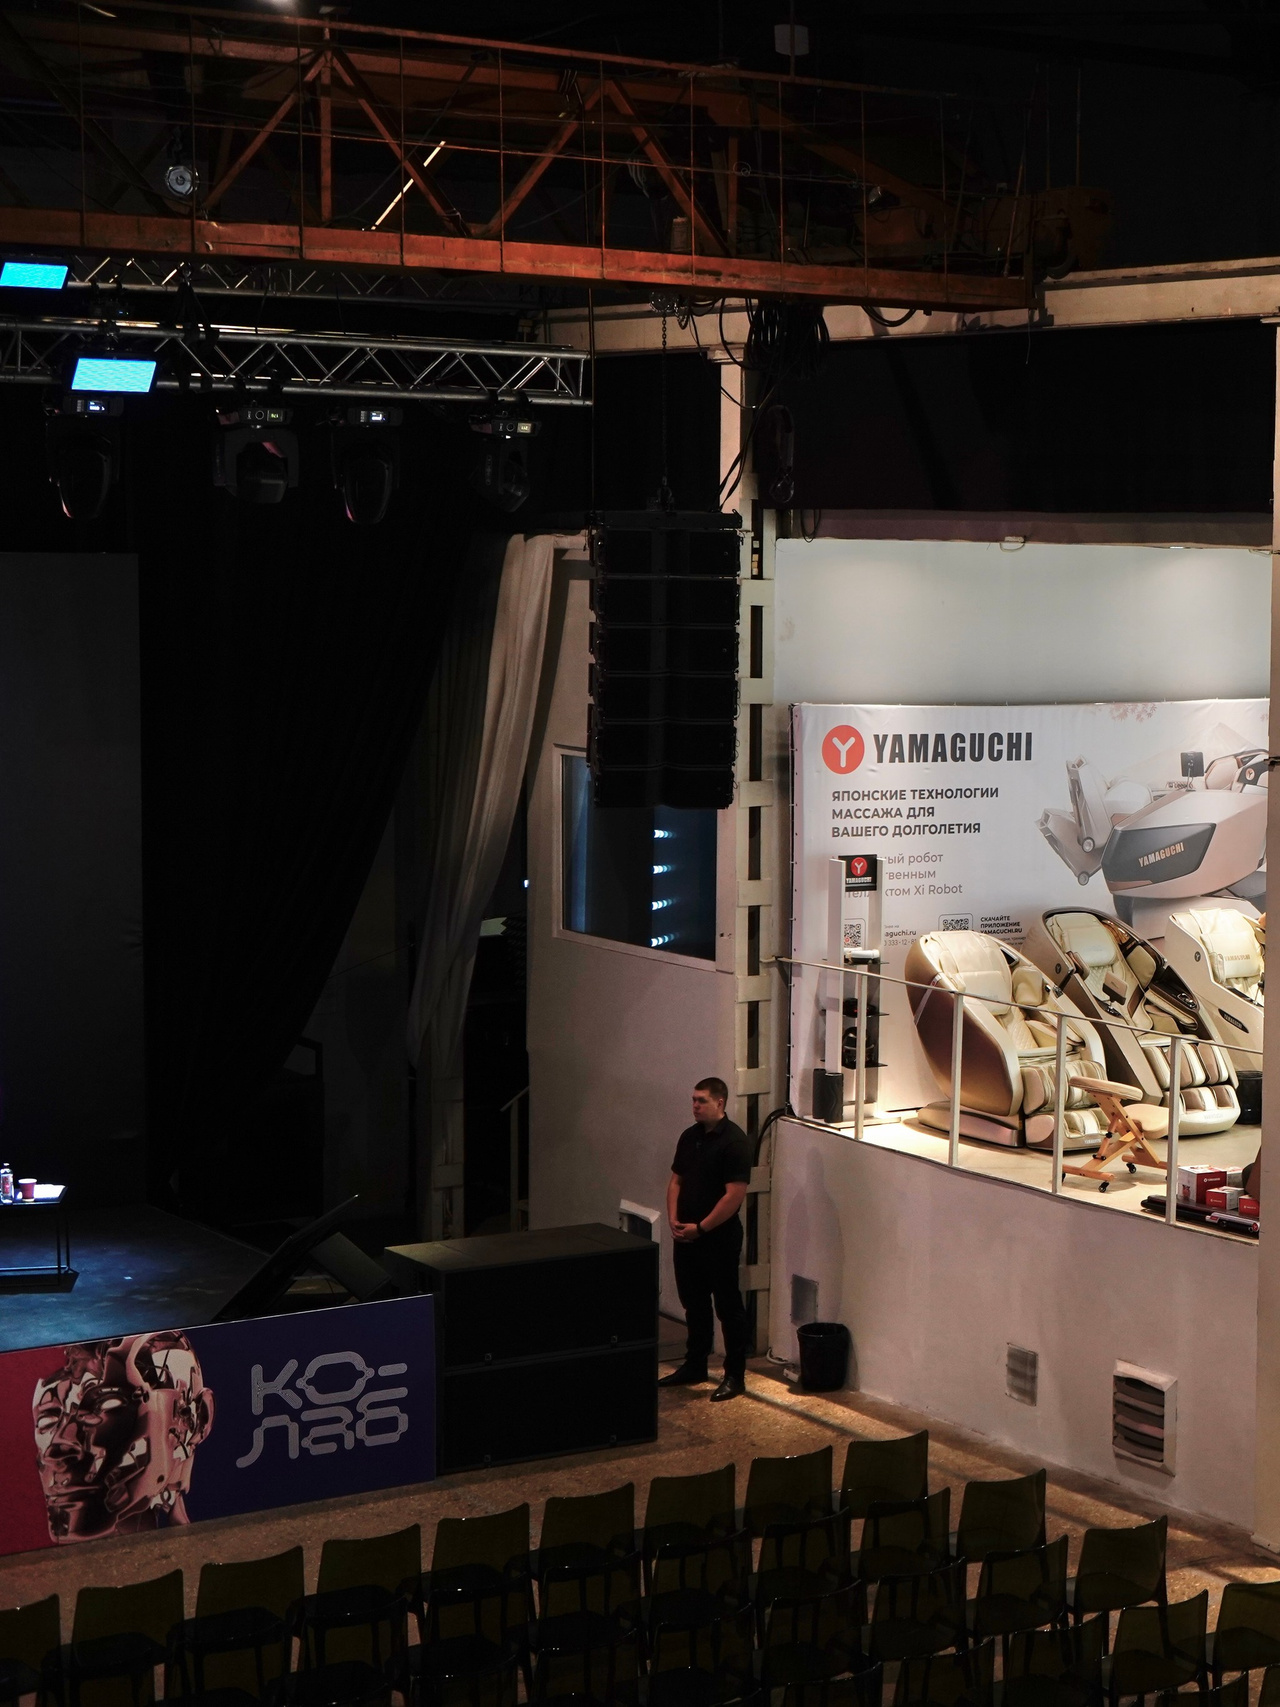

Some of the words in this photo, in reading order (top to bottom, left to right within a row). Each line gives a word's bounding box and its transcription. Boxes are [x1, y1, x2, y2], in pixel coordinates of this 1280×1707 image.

[873, 732, 1033, 764] YAMAGUCHI
[831, 789, 907, 803] ЯПОНСКИЕ
[910, 786, 1000, 801] ТЕХНОЛОГИИ
[831, 807, 904, 820] МАССАЖА
[906, 807, 935, 821] ДЛЯ
[831, 825, 889, 838] ВАШЕГО
[891, 822, 981, 838] ДОЛГОЛЕТИЯ
[908, 852, 944, 866] робот
[1138, 842, 1185, 868] YAMAGUCHI
[914, 885, 926, 896] Xi
[928, 883, 963, 896] Robot
[980, 915, 1011, 923] СКАЧАЙТЕ
[980, 921, 1022, 929] ПРИЛОЖЕНИЕ
